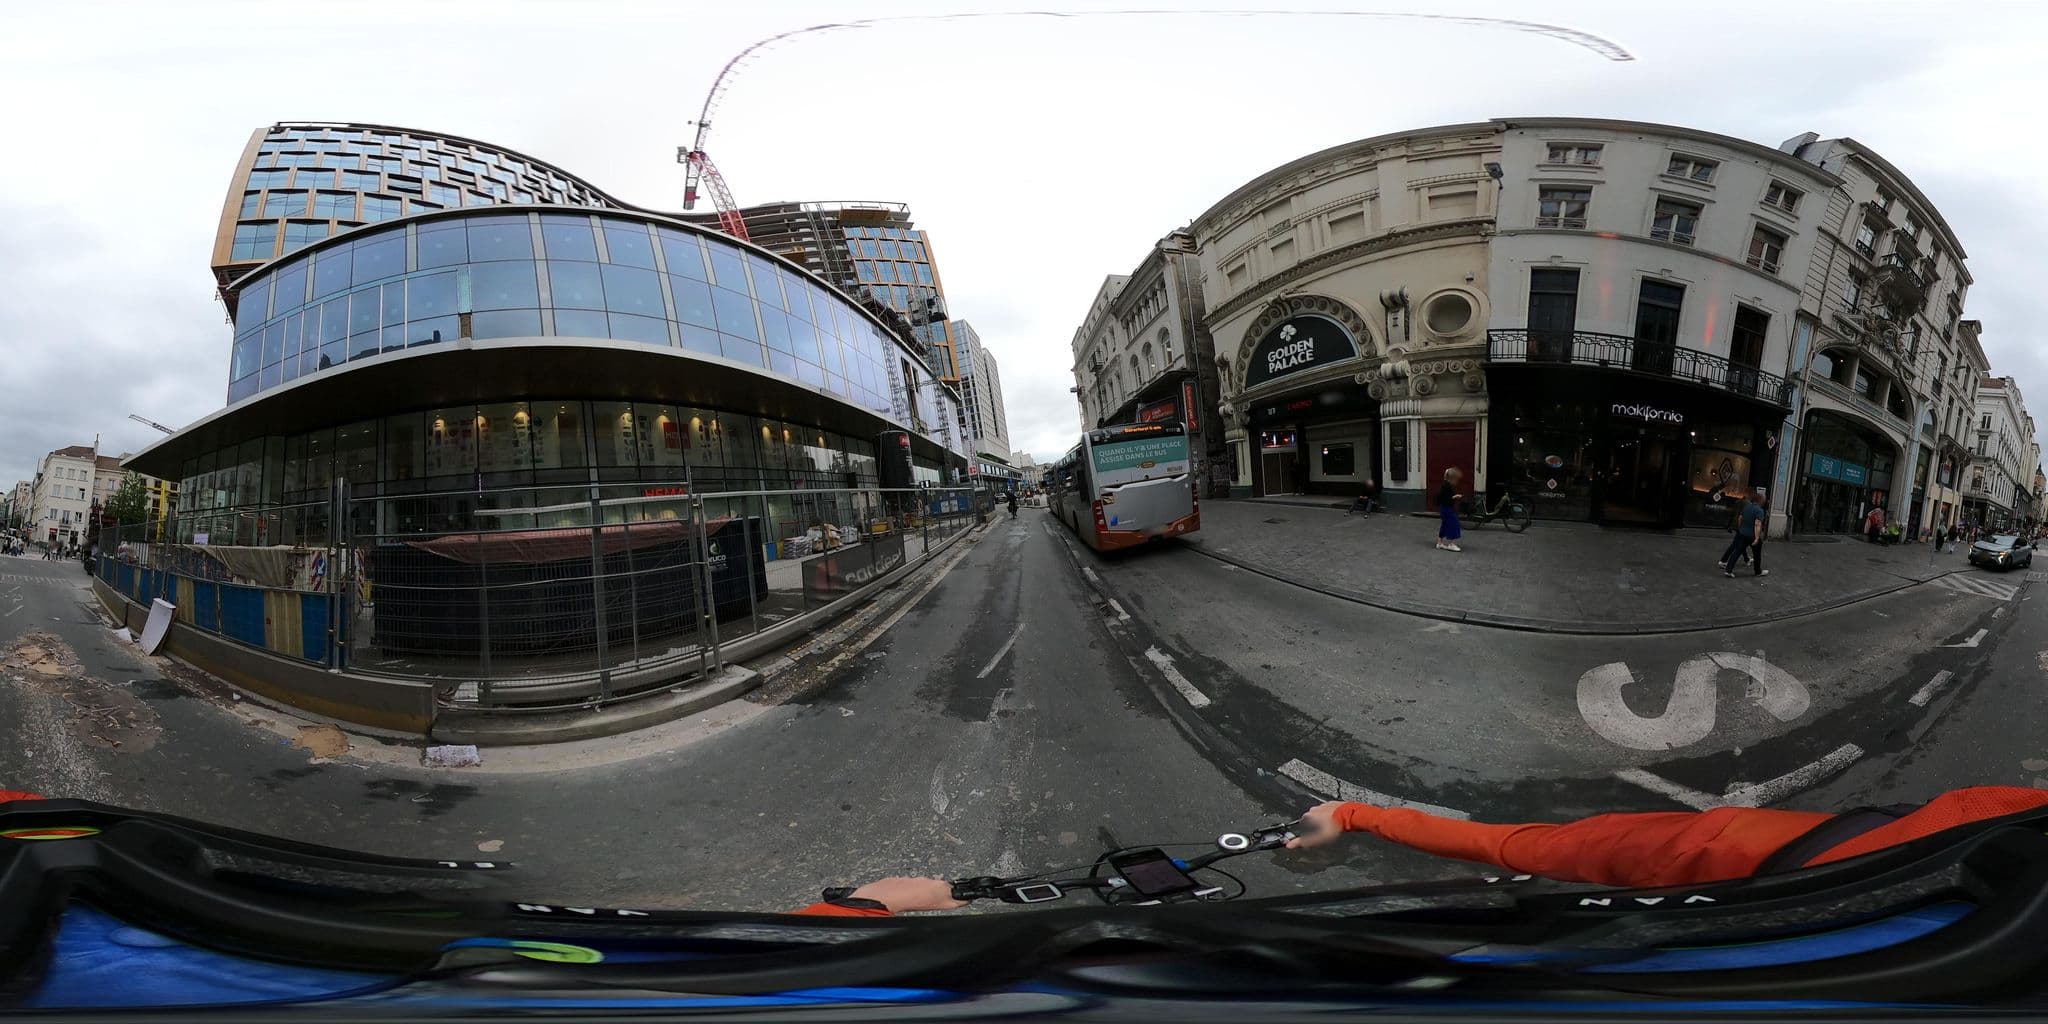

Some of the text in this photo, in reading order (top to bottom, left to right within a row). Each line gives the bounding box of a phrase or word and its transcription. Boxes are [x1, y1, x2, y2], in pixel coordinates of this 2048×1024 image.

[1268, 337, 1313, 362] GOLDEN
[1268, 349, 1314, 373] PALACE
[1612, 404, 1683, 422] makifornia
[1098, 447, 1126, 457] QUAND
[1100, 455, 1124, 464] ASSISE
[1125, 452, 1145, 461] DANS
